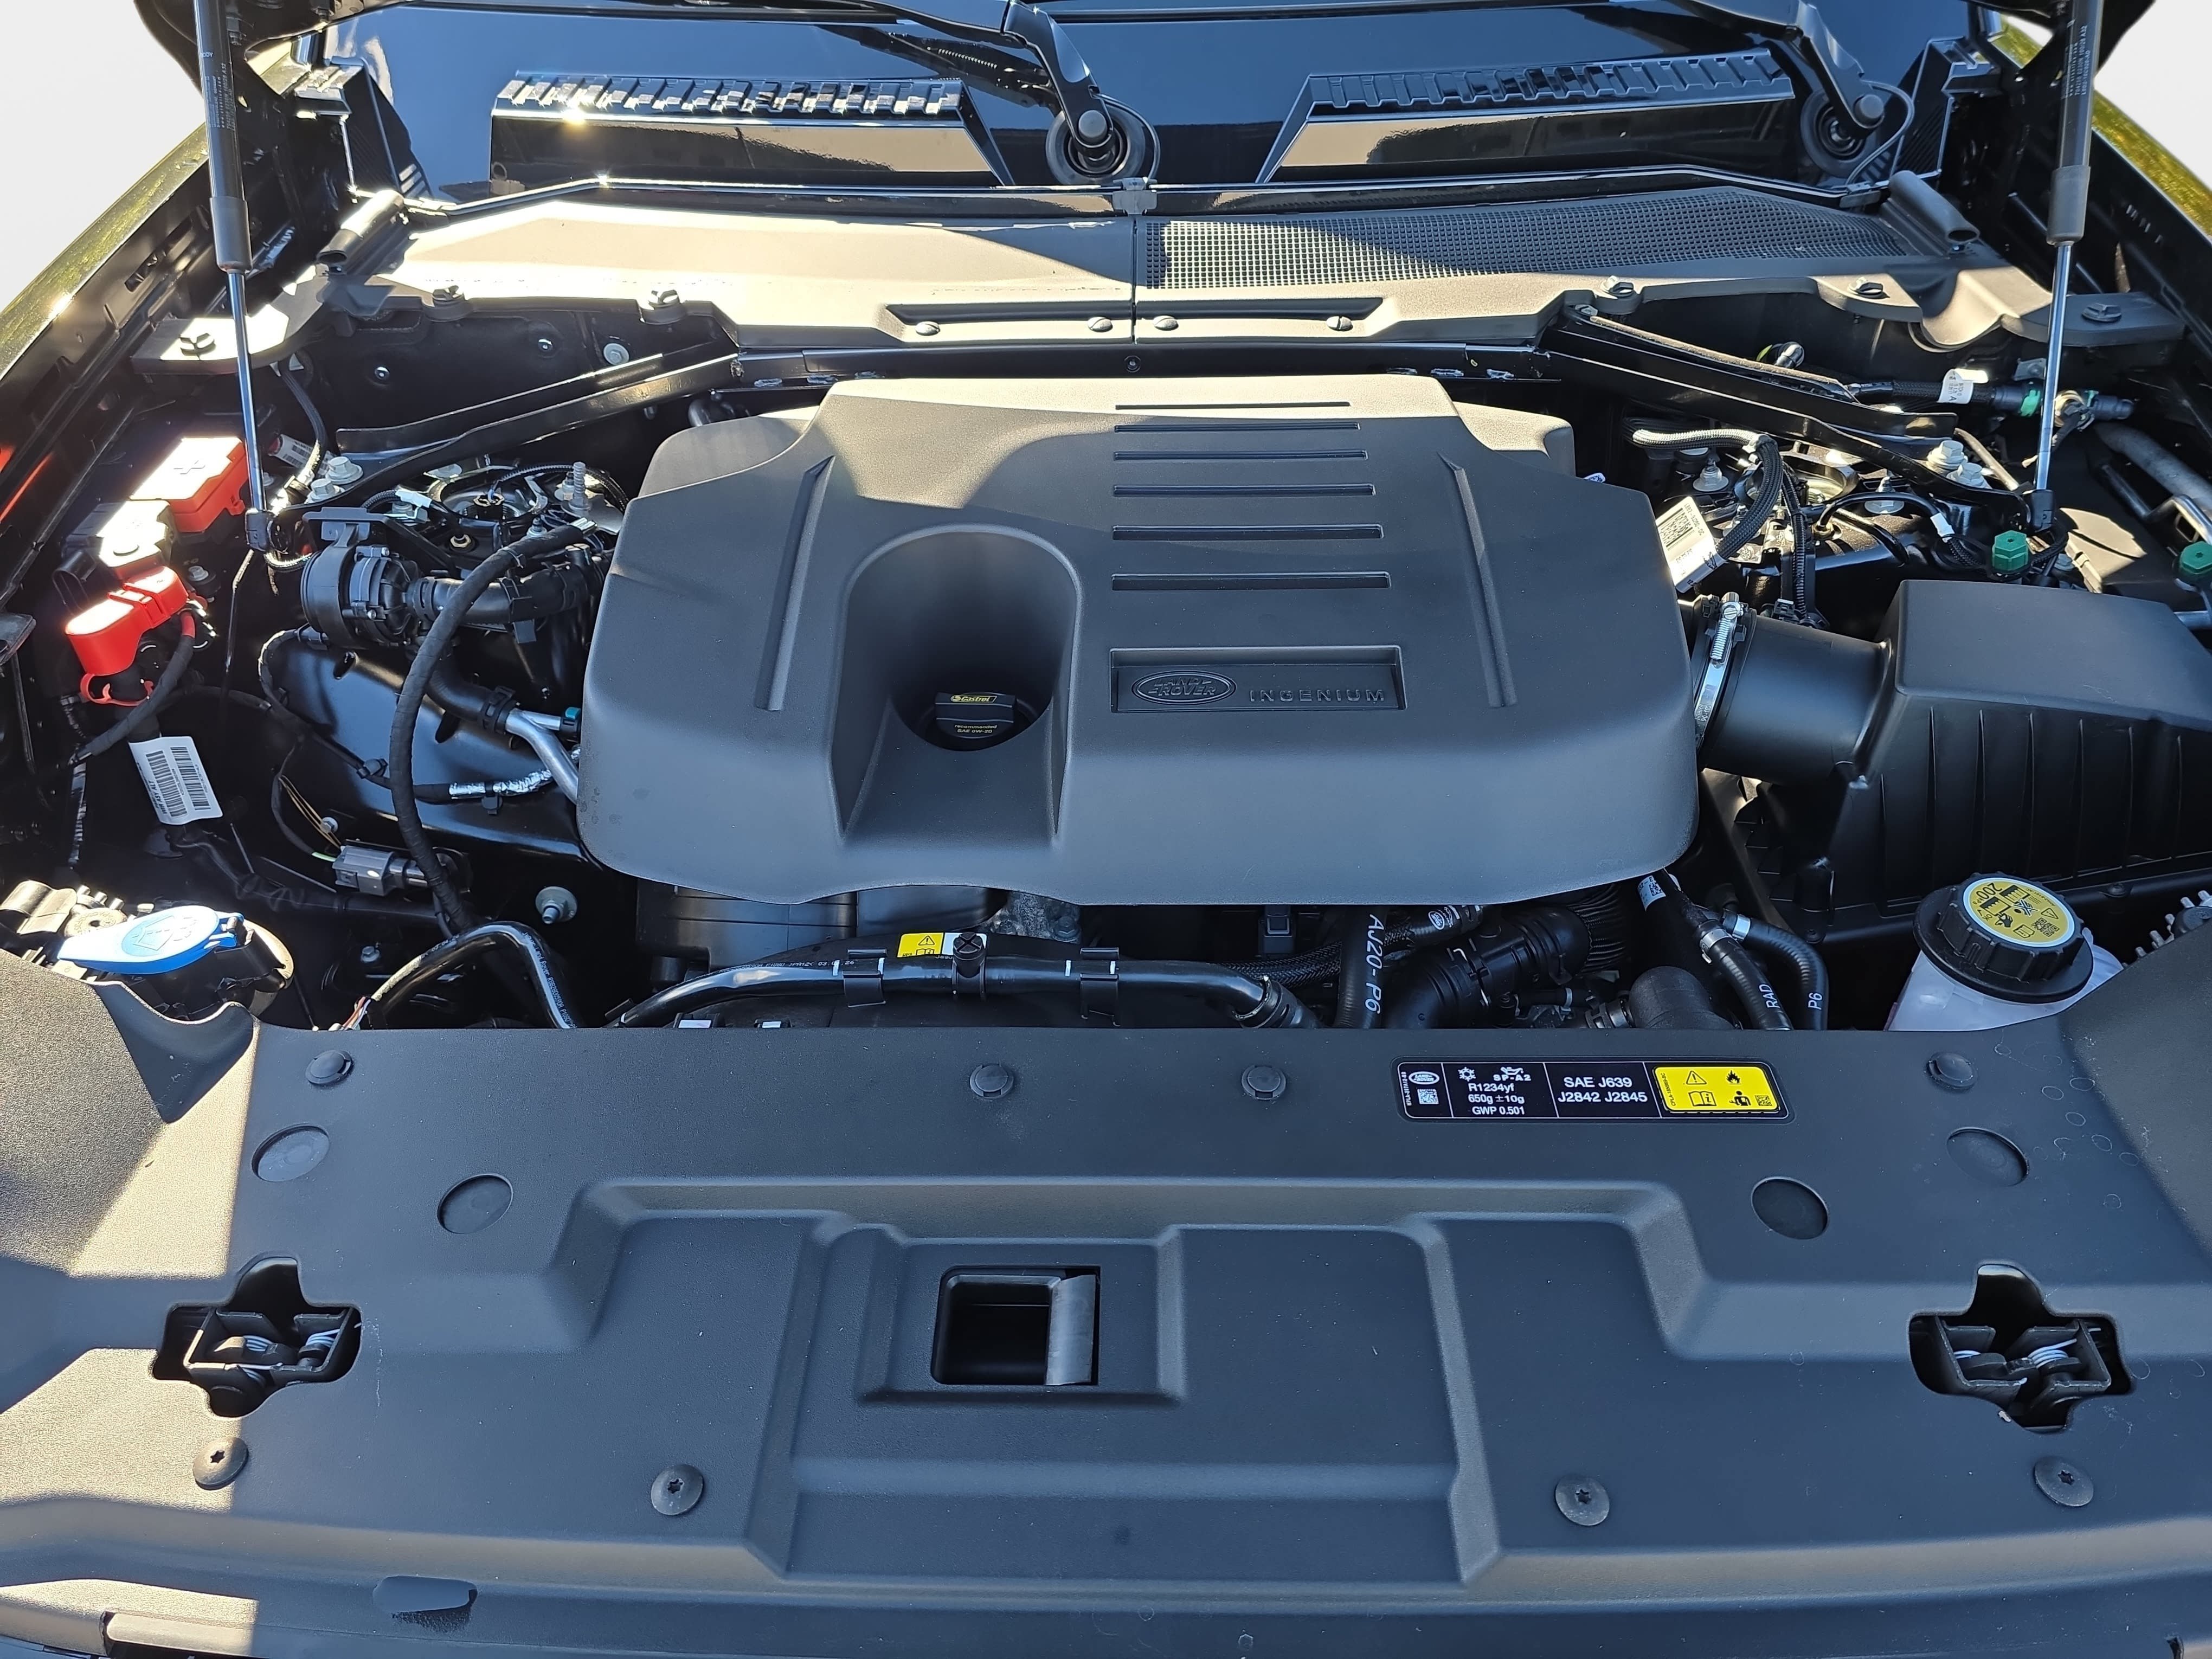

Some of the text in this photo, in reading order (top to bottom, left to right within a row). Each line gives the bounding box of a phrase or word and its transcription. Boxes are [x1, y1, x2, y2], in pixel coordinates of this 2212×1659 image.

[1154, 677, 1200, 686] LAND
[1158, 685, 1217, 697] ROVER
[1250, 690, 1385, 702] INGENIUM
[1976, 883, 2002, 900] 200
[1365, 914, 1385, 1014] AJ20- P6
[1759, 984, 1781, 1008] RAD
[1808, 992, 1823, 1010] P6
[1468, 1083, 1514, 1093] R1234yf
[1564, 1077, 1632, 1088] SAE J639
[1468, 1094, 1525, 1104] 650g ±10g
[1558, 1091, 1648, 1102] J2842 J2845
[1472, 1107, 1525, 1115] GWP 0.501
